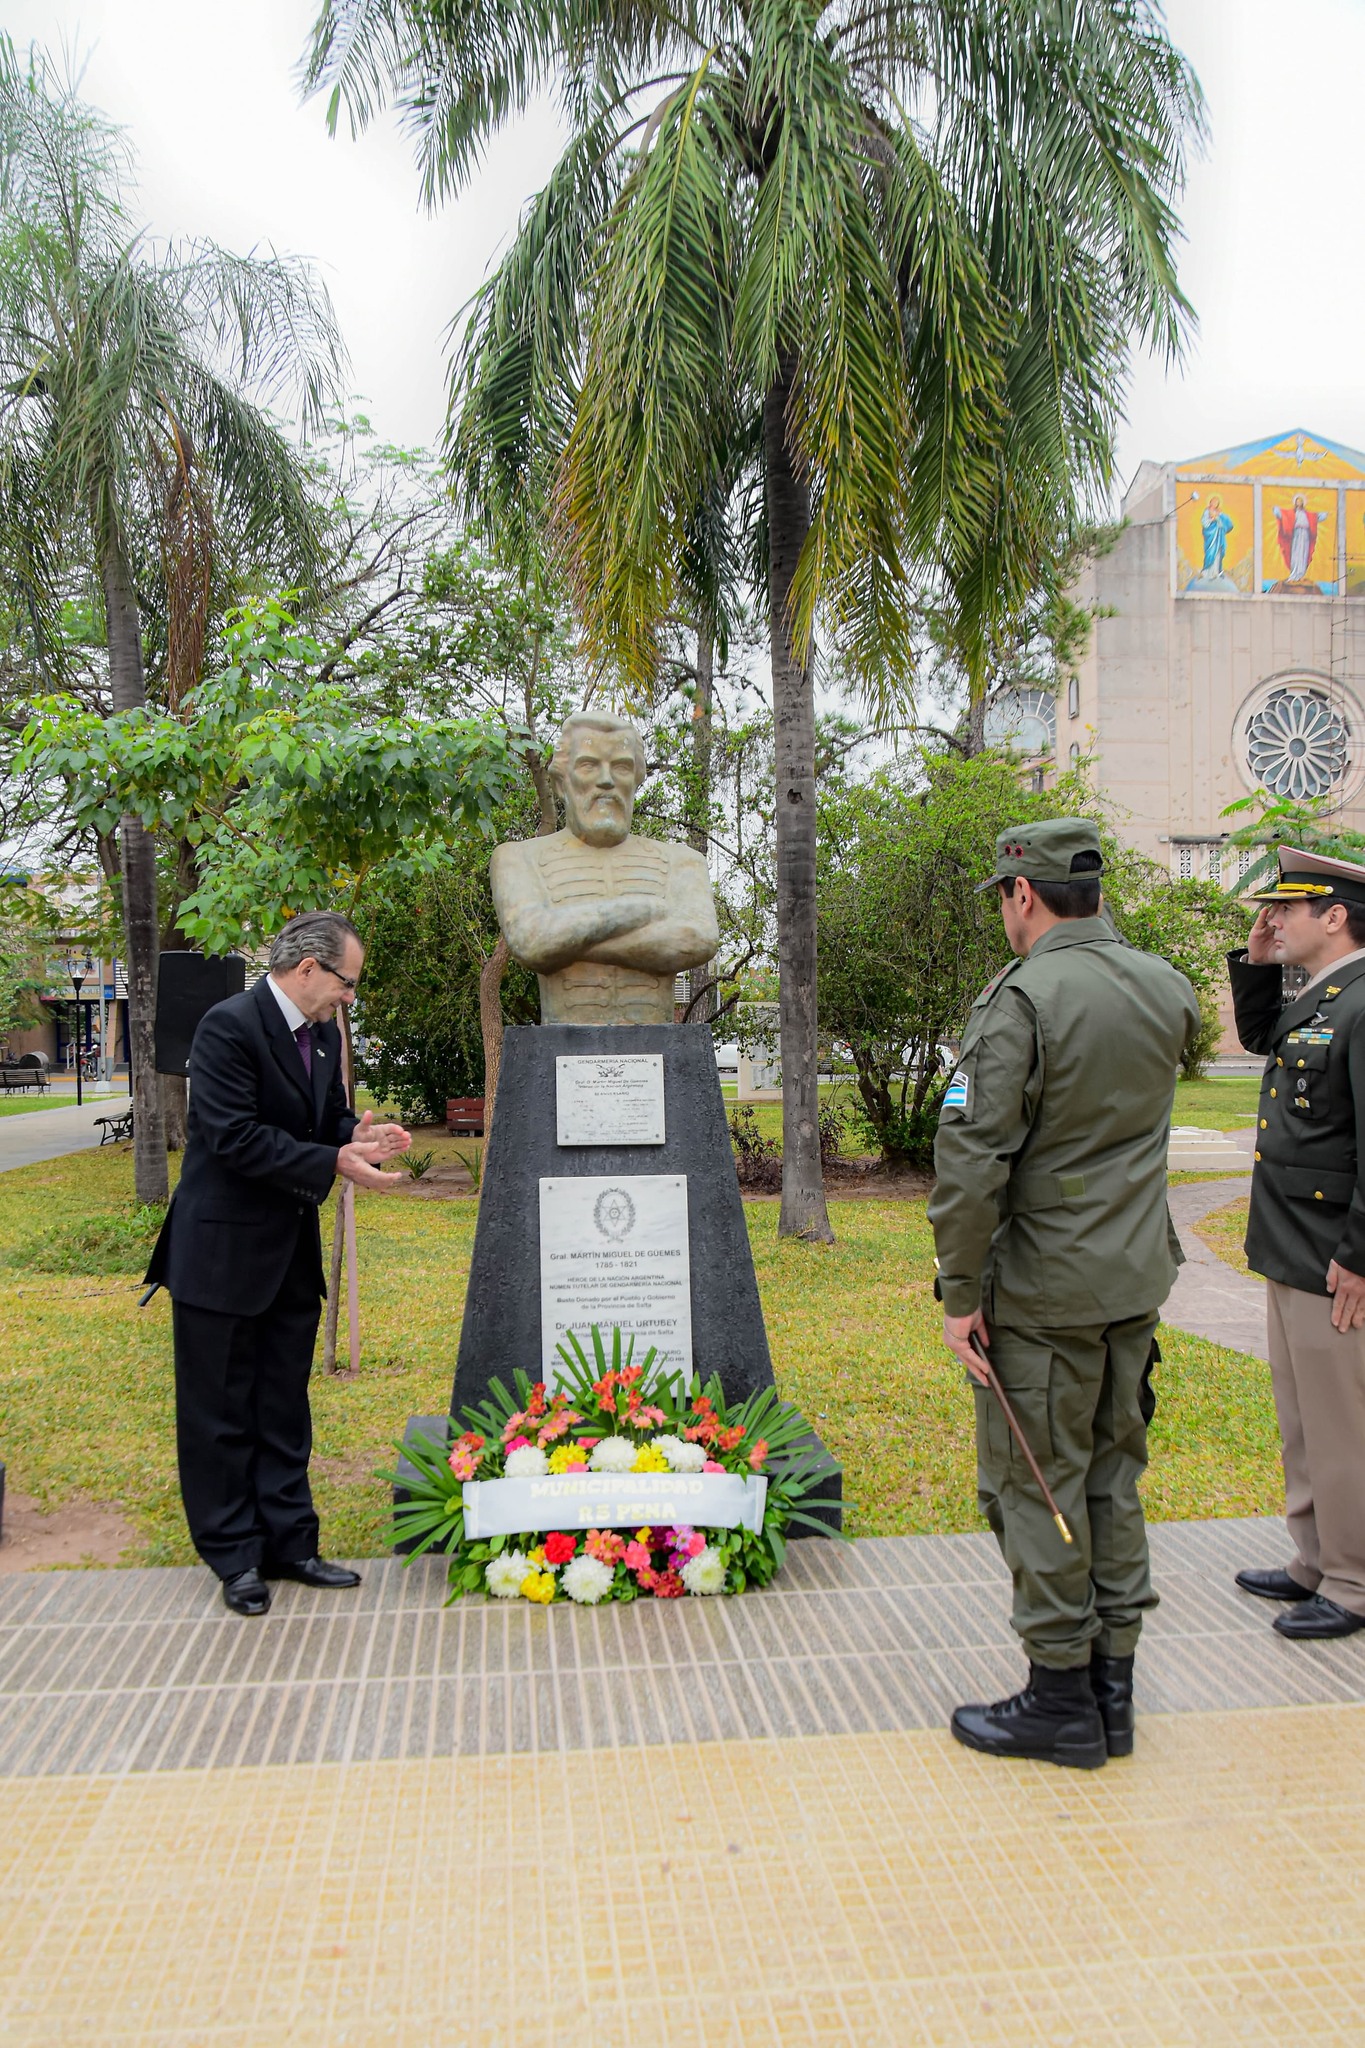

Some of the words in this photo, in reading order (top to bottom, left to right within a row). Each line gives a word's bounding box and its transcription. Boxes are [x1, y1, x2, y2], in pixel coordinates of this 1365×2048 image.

[570, 1321, 594, 1330] JUAN
[596, 1320, 633, 1328] MANUEL
[636, 1319, 678, 1327] URTUBEY
[530, 1479, 704, 1498] MUNICIPALIDAD
